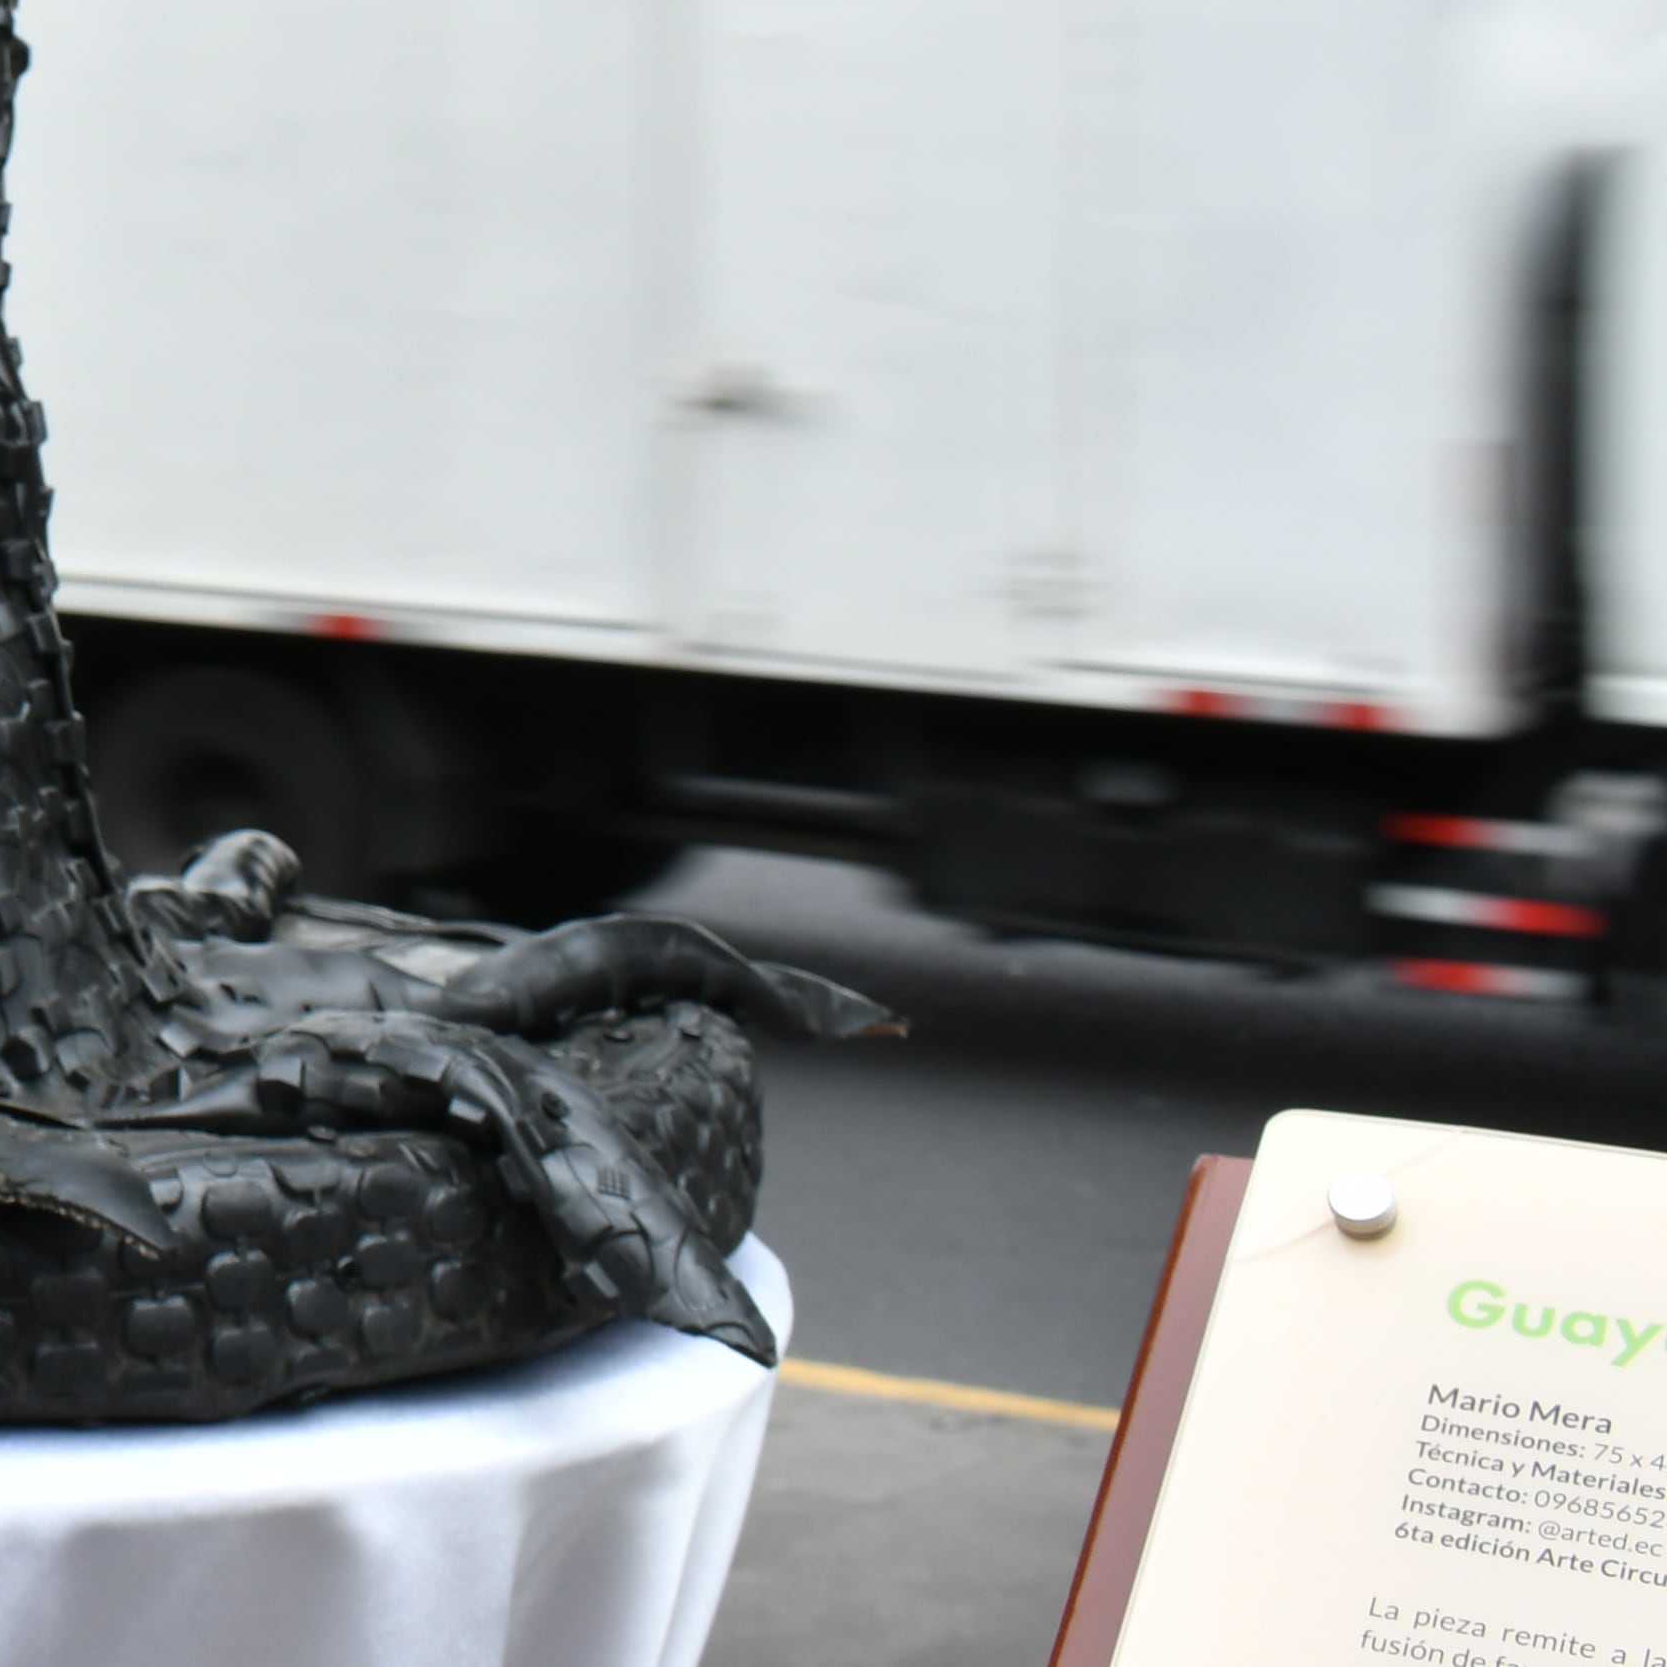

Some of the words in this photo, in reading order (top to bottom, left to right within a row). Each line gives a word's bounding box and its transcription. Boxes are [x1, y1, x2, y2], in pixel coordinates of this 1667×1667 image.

[1446, 1279, 1667, 1367] Guay
[1428, 1384, 1521, 1419] Mario
[1529, 1400, 1612, 1434] Mera
[1415, 1440, 1505, 1472] Técnica
[1511, 1461, 1525, 1479] y
[1531, 1460, 1667, 1500] Materiales
[1420, 1414, 1585, 1458] Dimensiones:
[1594, 1442, 1624, 1464] 75
[1629, 1453, 1644, 1469] x
[1401, 1494, 1532, 1533] Instagram:
[1538, 1520, 1664, 1558] @arted.ec
[1408, 1468, 1528, 1504] Contacto:
[1534, 1490, 1667, 1529] 09685652
[1394, 1521, 1434, 1544] 6ta
[1440, 1533, 1531, 1562] edición
[1535, 1547, 1595, 1573] Arte
[1600, 1559, 1667, 1587] Circu
[1360, 1629, 1445, 1665] fusión
[1368, 1596, 1400, 1622] La
[1413, 1607, 1487, 1638] pieza
[1502, 1627, 1597, 1659] remite
[1611, 1648, 1627, 1665] a
